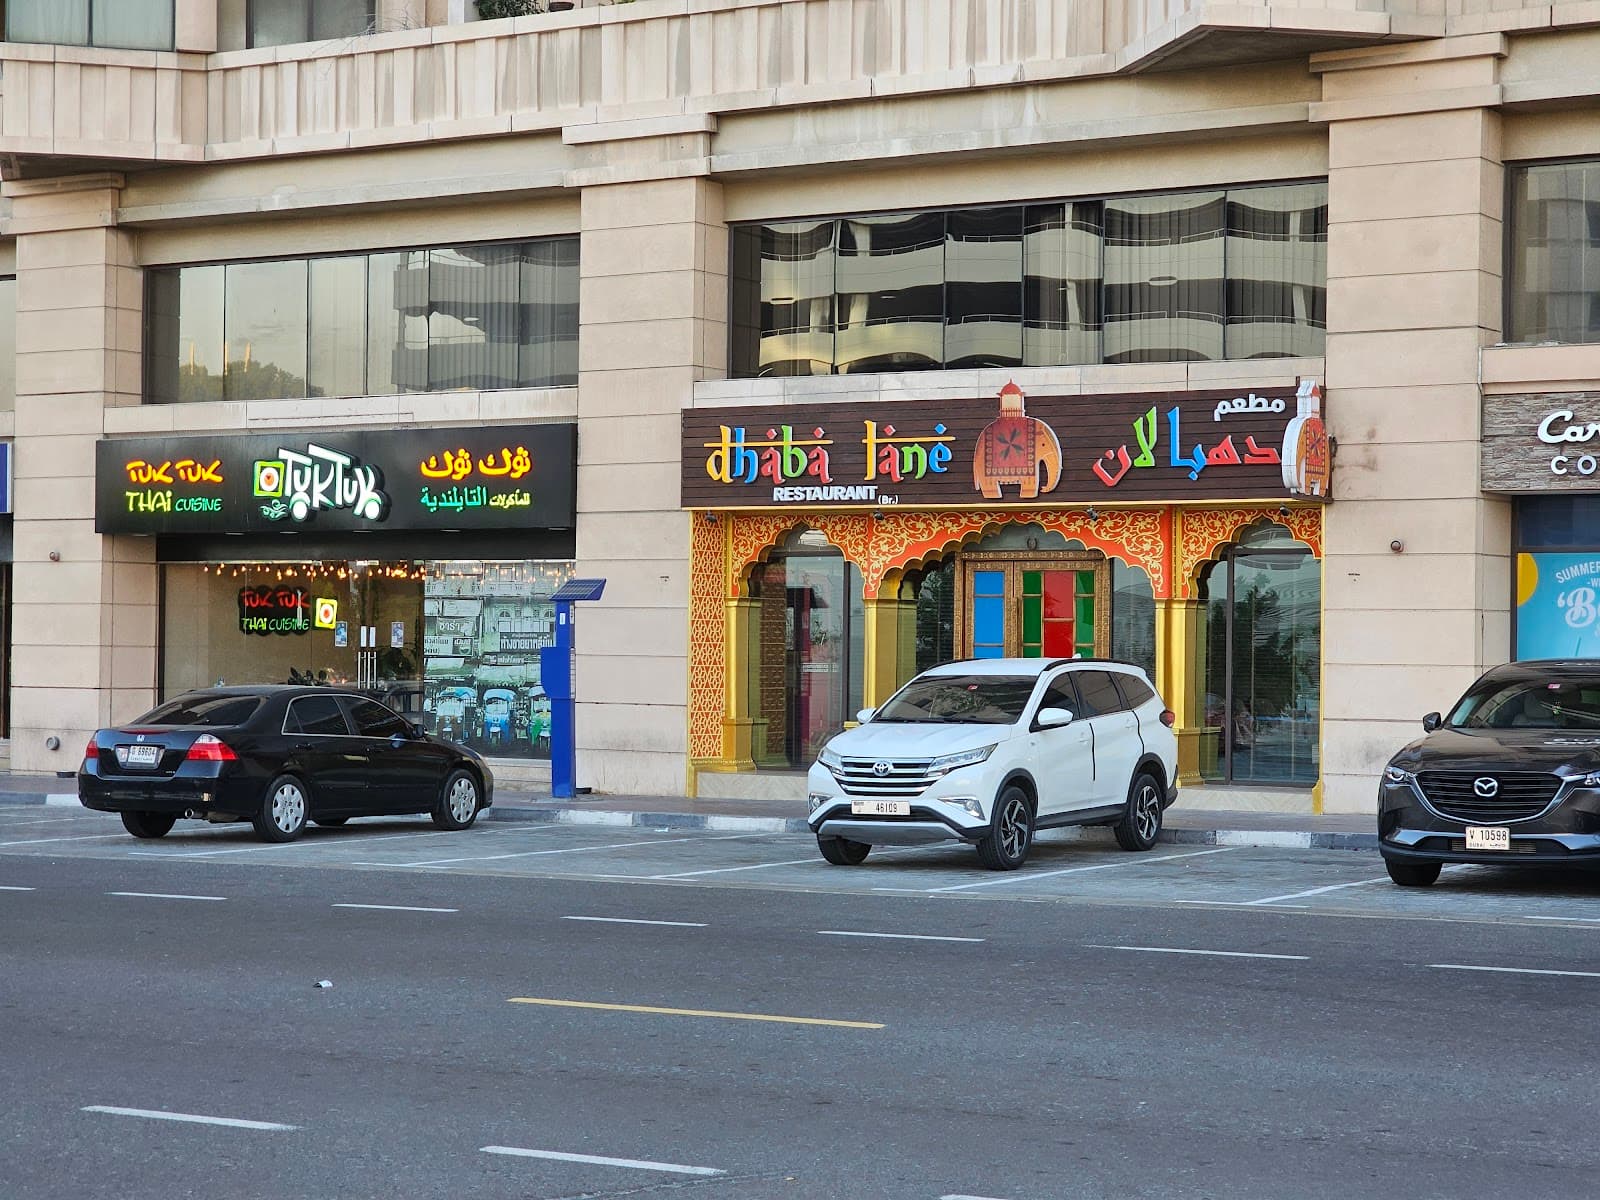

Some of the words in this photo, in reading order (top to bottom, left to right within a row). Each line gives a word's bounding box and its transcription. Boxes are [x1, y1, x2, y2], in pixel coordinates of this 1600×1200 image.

[1213, 394, 1286, 422] مطعم
[421, 448, 473, 480] توك
[478, 446, 532, 479] توك
[704, 425, 834, 484] dhaba
[862, 420, 956, 482] lane
[126, 461, 174, 483] TUK
[175, 460, 223, 483] TUK
[420, 485, 487, 512] التايلندية
[772, 485, 879, 503] RESTAURANT
[241, 590, 274, 607] TUK
[876, 803, 898, 813] 46109
[1480, 830, 1507, 841] 10598
